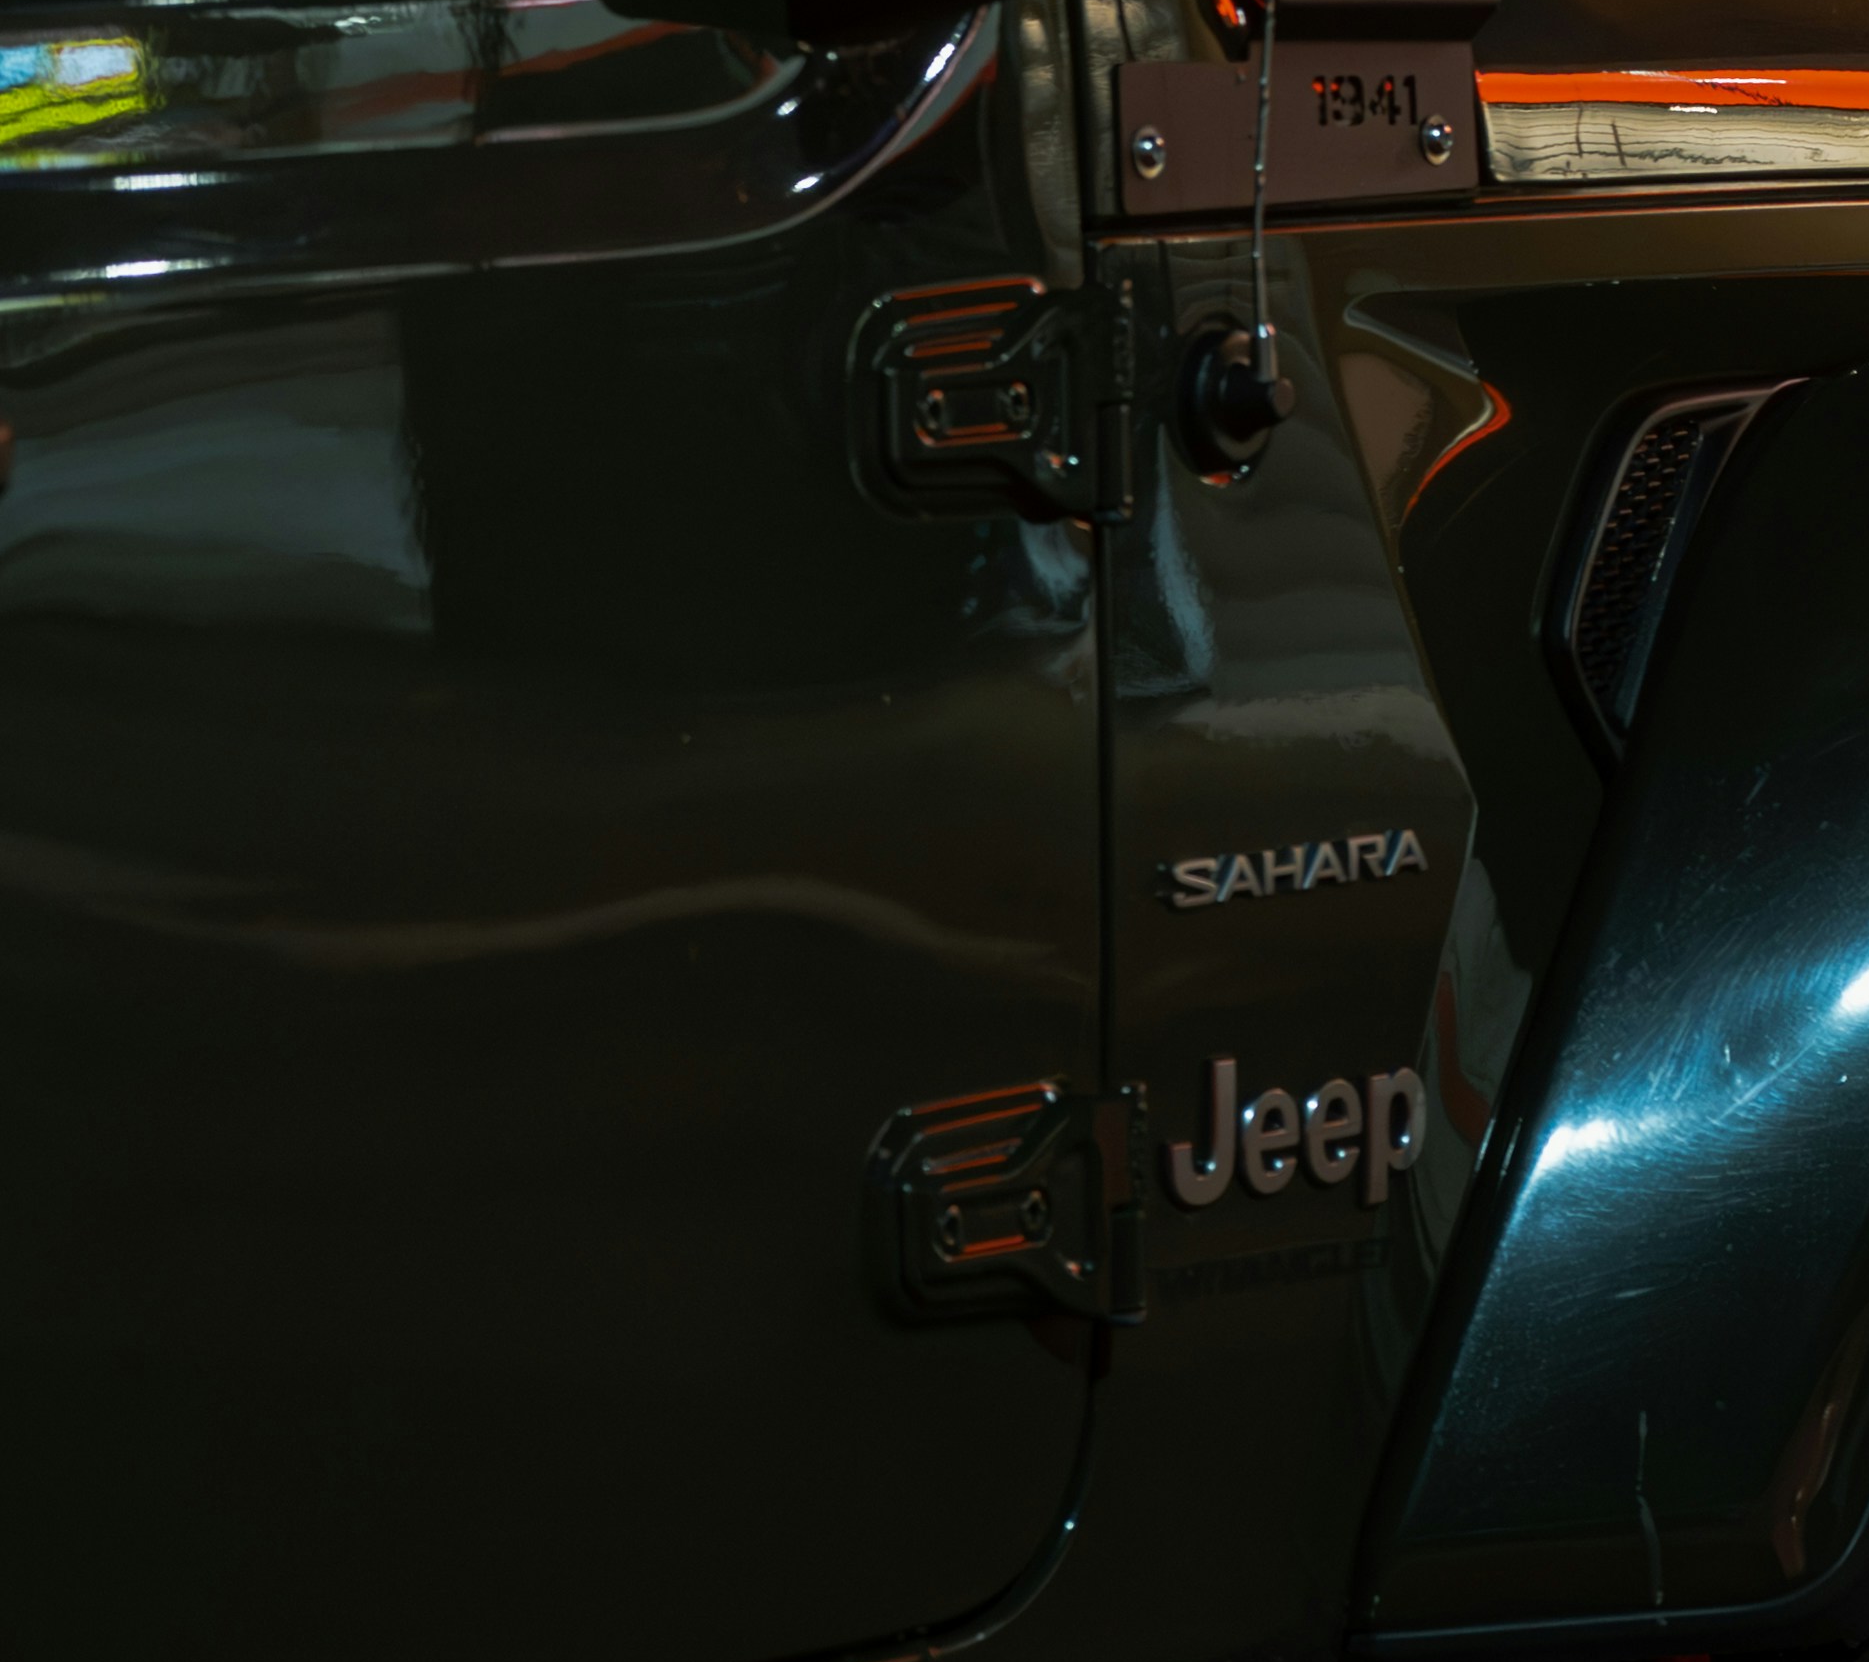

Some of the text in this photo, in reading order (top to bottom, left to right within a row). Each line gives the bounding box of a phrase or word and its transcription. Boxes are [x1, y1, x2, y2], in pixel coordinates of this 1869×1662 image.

[1311, 74, 1418, 128] 1941
[1168, 828, 1429, 910] SAHARA
[1165, 1055, 1427, 1207] Jeep
